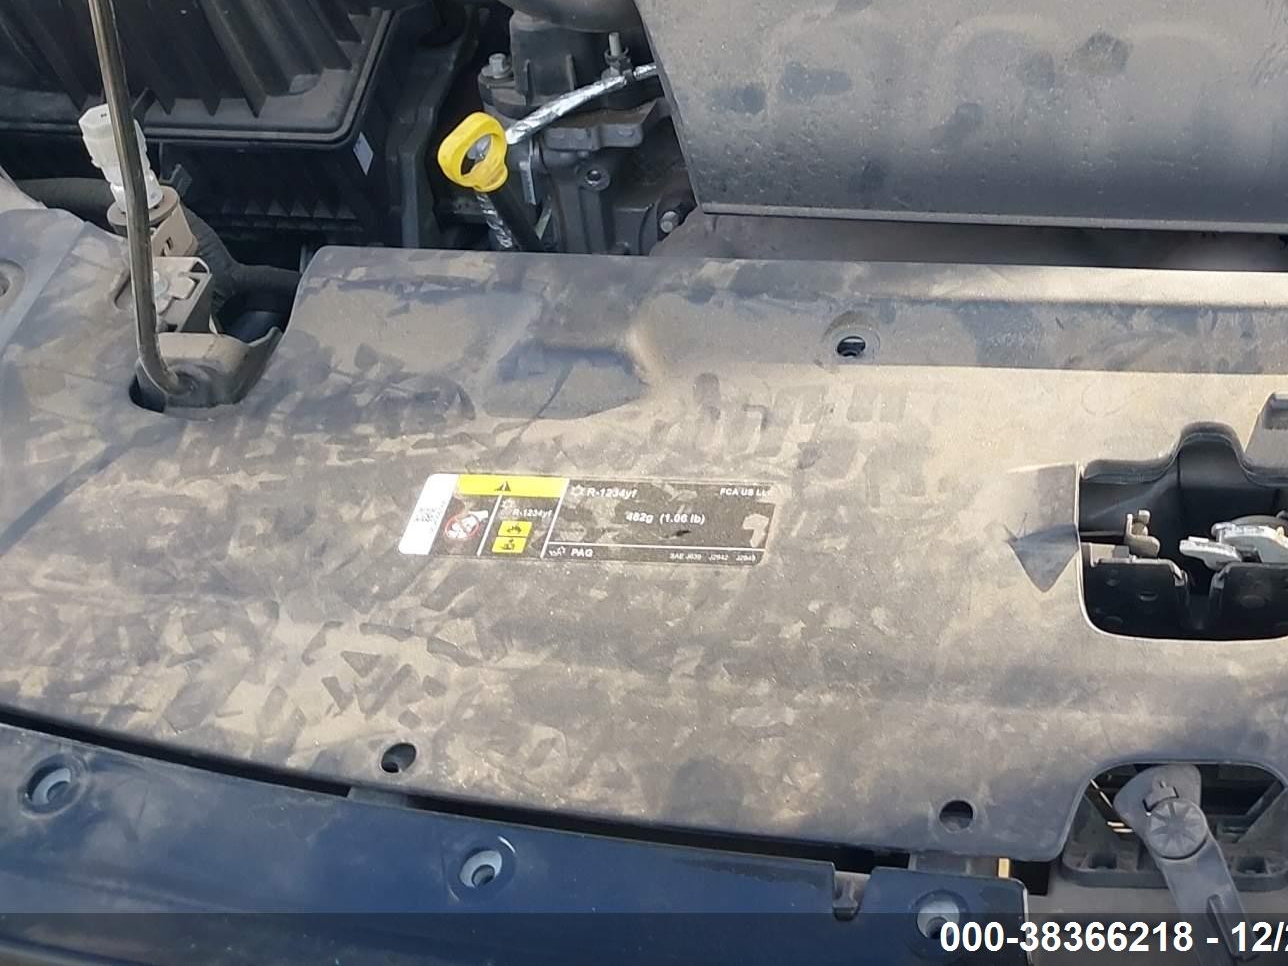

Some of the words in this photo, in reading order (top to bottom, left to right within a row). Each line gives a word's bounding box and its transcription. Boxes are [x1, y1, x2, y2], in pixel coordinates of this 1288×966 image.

[586, 487, 638, 500] R-1234yf
[719, 487, 739, 496] FCA
[740, 488, 754, 497] US
[511, 508, 553, 519] R-1234yf
[689, 513, 706, 525] lb)
[570, 548, 594, 558] PAG
